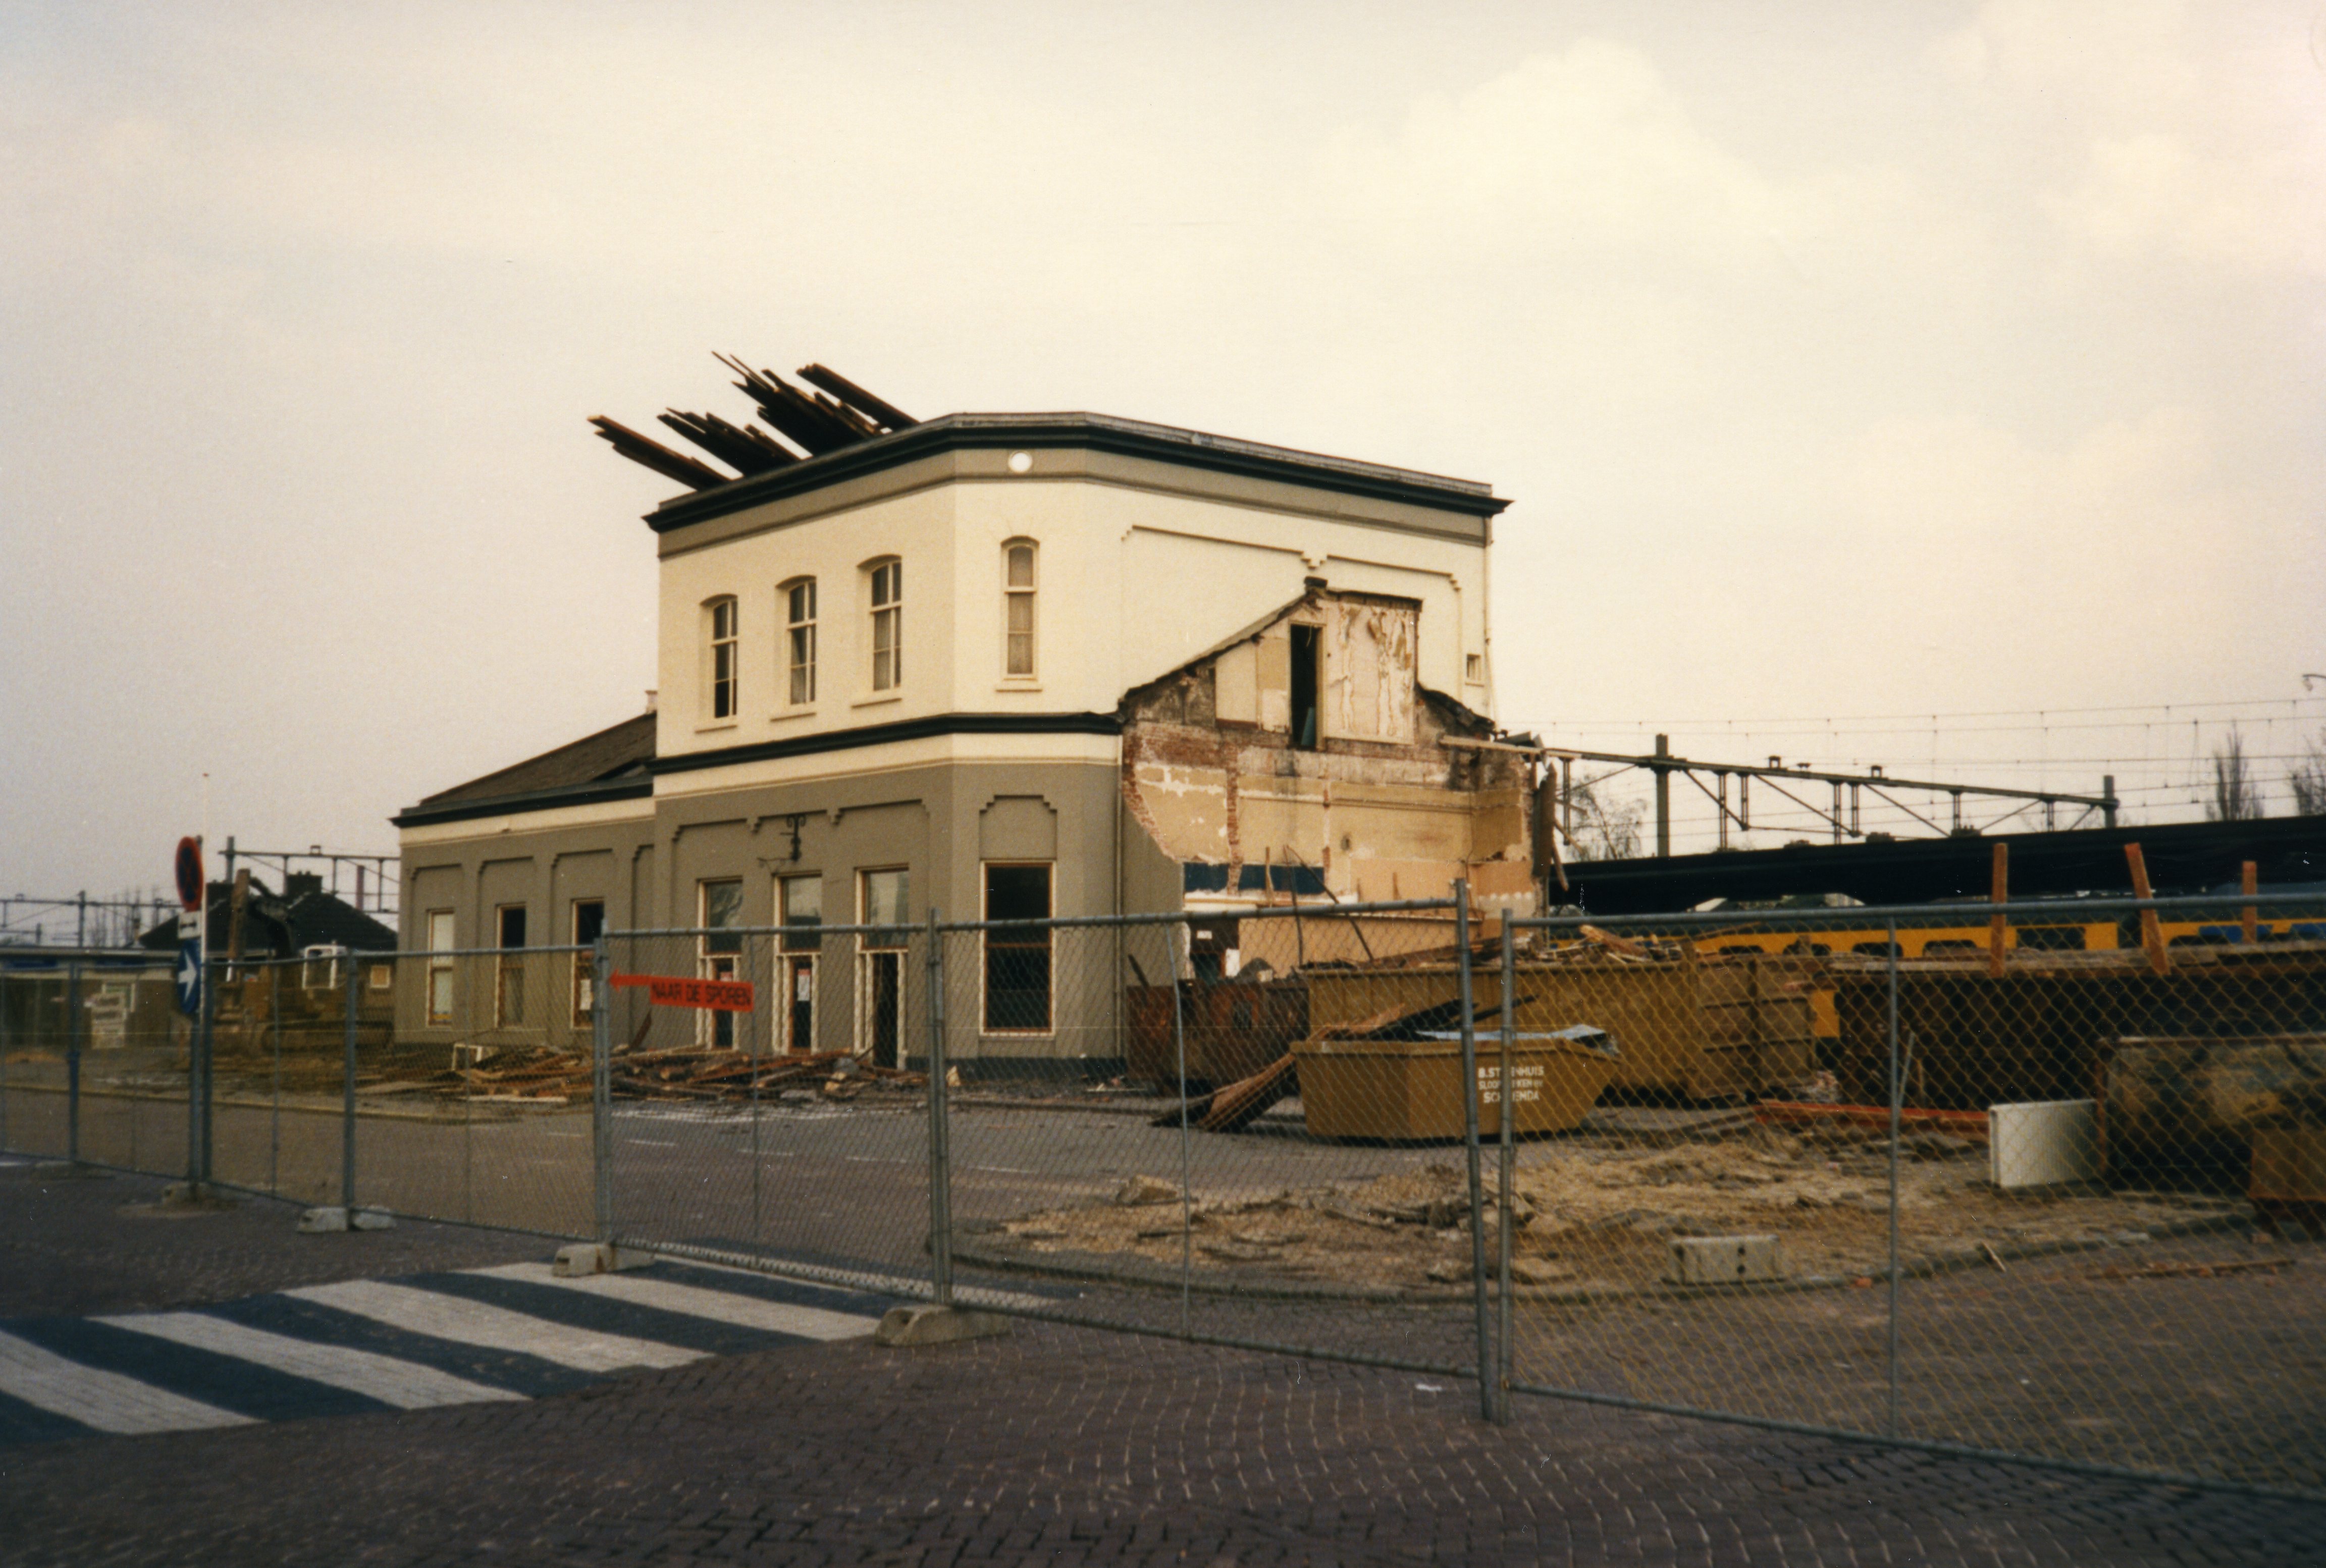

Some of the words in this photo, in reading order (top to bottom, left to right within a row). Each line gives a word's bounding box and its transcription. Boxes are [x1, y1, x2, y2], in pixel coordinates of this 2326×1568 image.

[651, 982, 681, 1000] NAAR
[685, 984, 700, 1003] DE
[705, 985, 751, 1006] SPOREN
[1483, 1090, 1540, 1104] SCHEMDA
